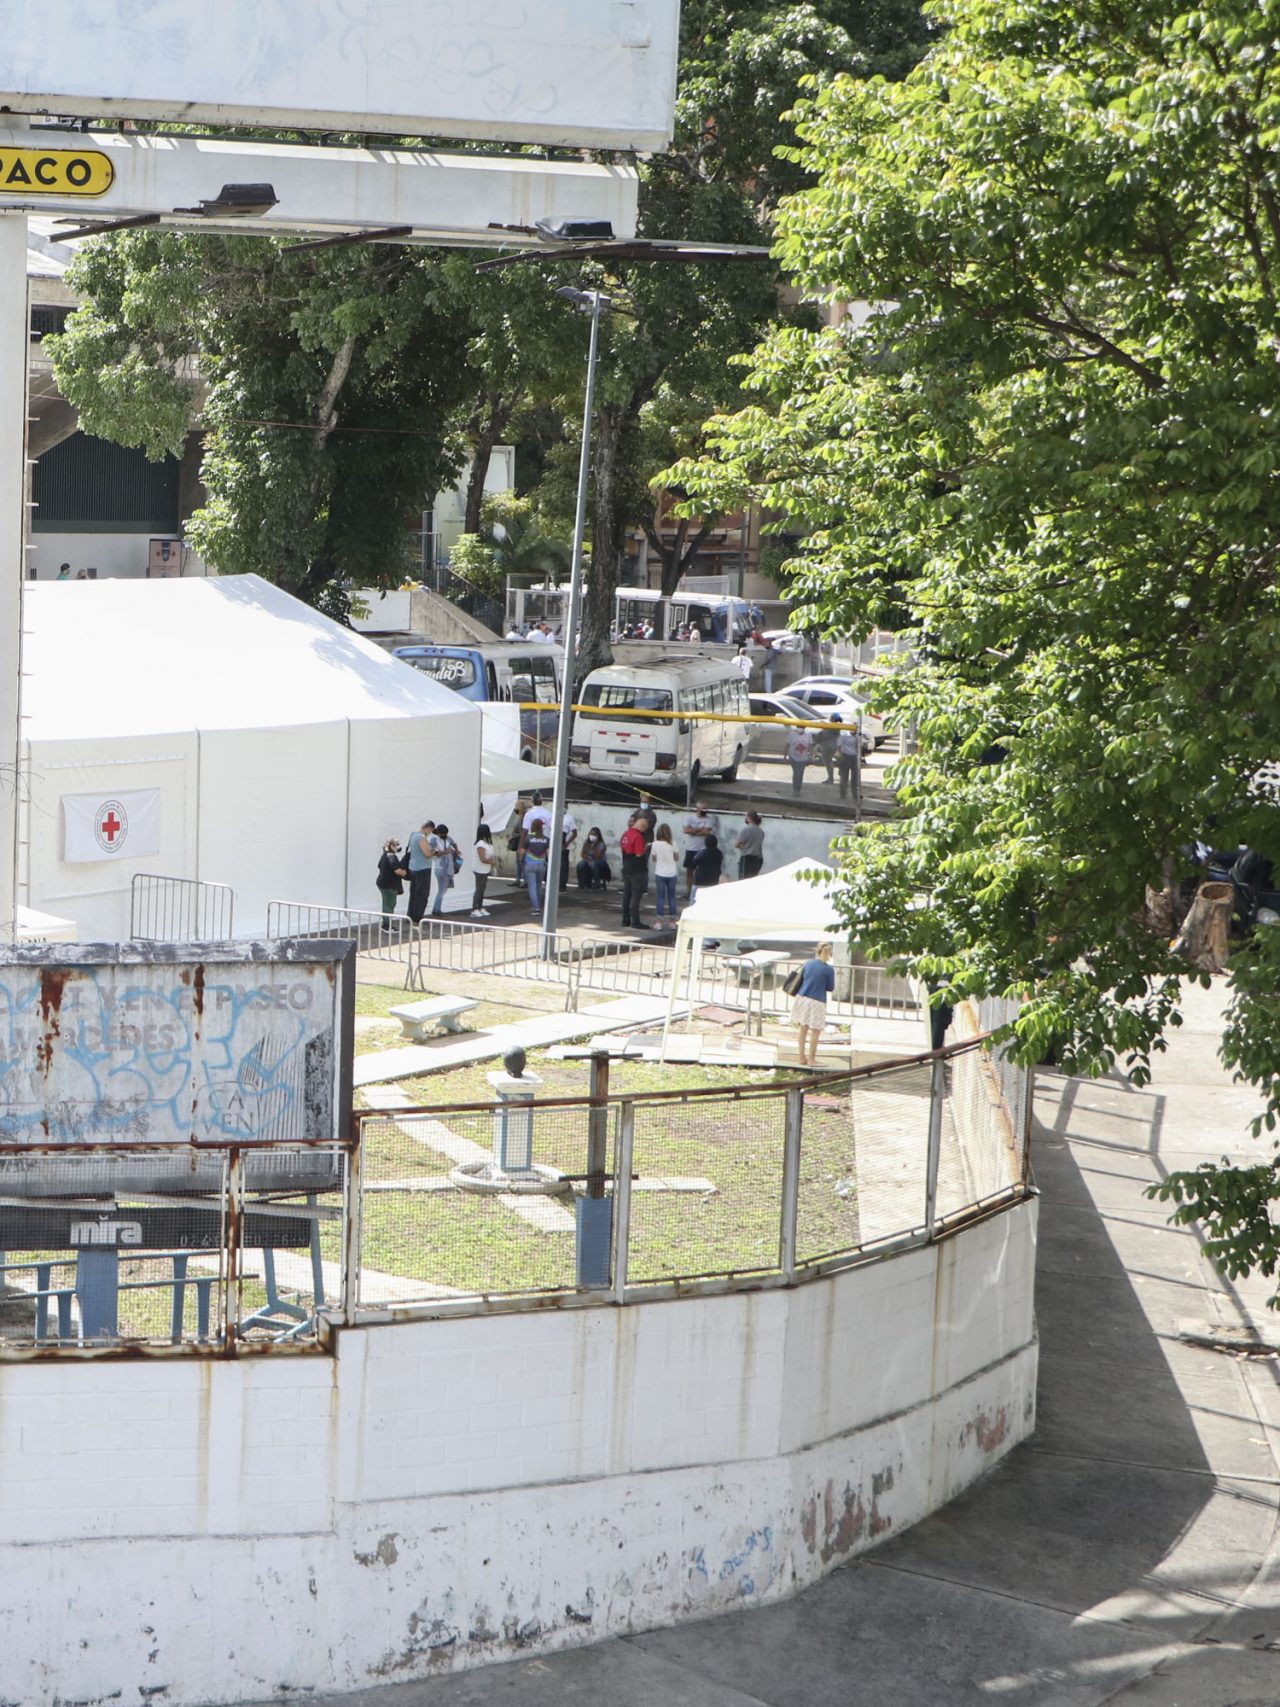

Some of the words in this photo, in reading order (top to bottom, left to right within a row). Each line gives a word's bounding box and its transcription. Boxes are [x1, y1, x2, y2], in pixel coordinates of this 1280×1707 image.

[96, 986, 117, 1012] Y
[215, 982, 313, 1011] PASEO
[13, 1023, 175, 1056] MRCEDES
